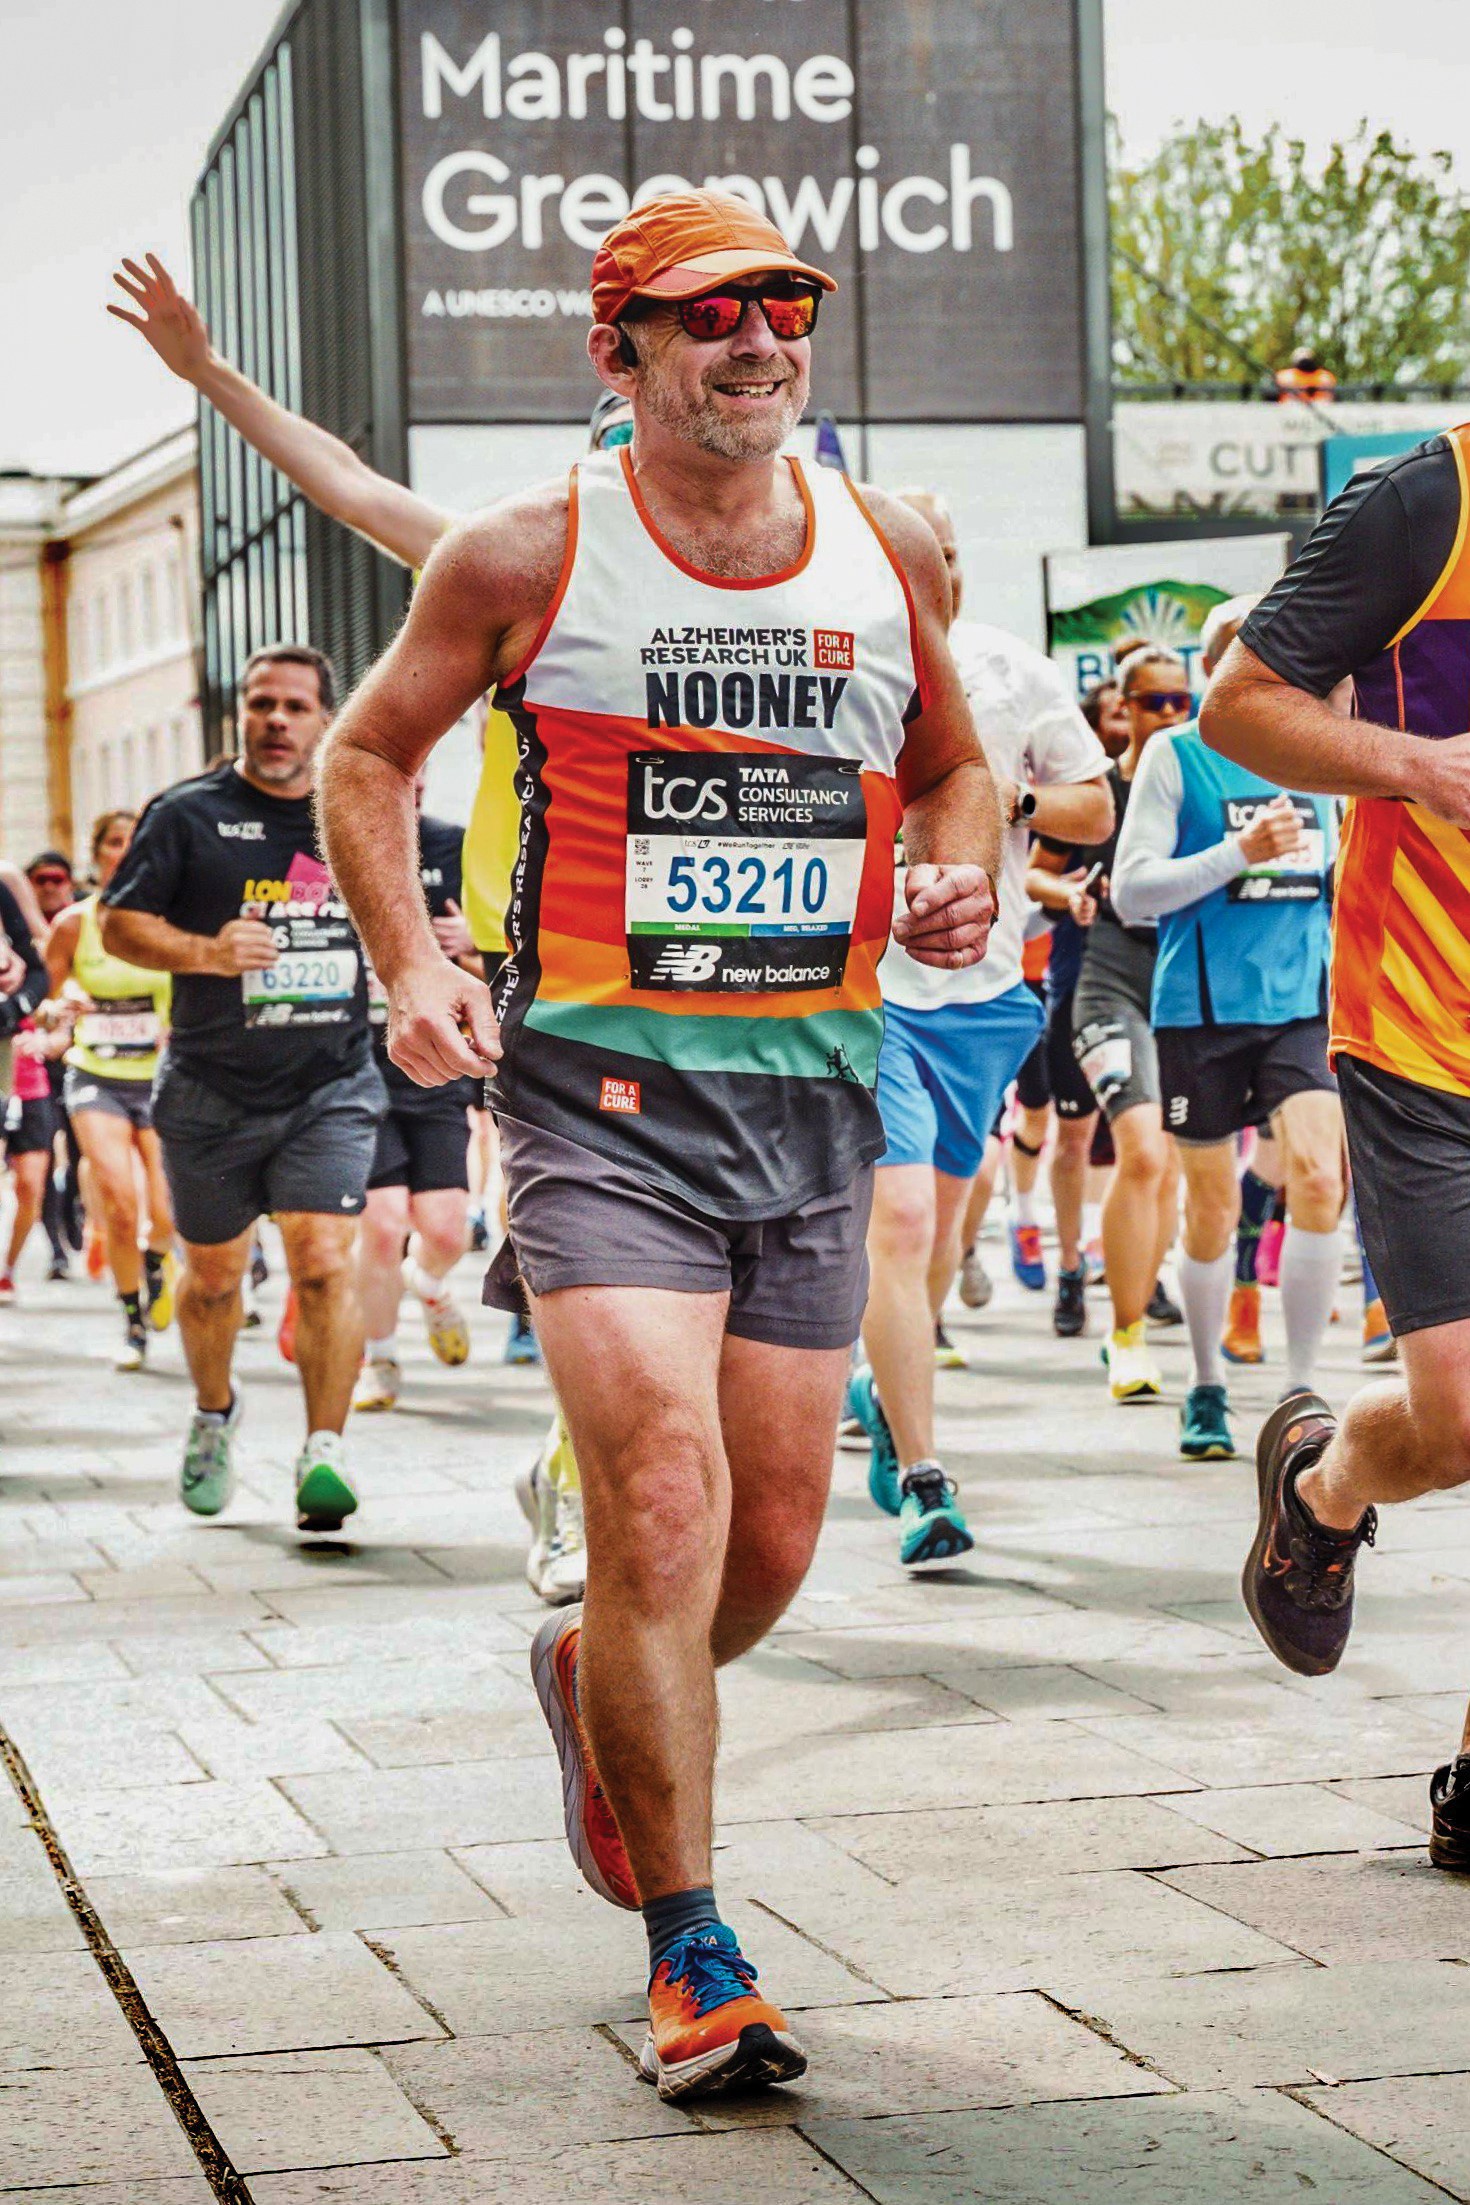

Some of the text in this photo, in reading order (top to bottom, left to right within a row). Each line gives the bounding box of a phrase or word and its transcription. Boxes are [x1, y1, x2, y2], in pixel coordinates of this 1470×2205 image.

[421, 27, 855, 122] Maritime
[421, 143, 1015, 252] Grewich
[446, 288, 557, 318] UNESCO
[650, 627, 807, 647] ALZHEIMER'S
[817, 633, 851, 650] FOR A
[640, 648, 808, 667] RESEARCH UK
[818, 650, 851, 667] CURE
[645, 670, 849, 729] NOONEY
[739, 767, 789, 784] TATA
[643, 765, 728, 821] tcs
[738, 787, 850, 806] CONSULTANCY
[738, 807, 814, 823] SERVICES
[666, 856, 828, 914] 53210
[650, 944, 830, 984] NB new balance
[605, 1080, 637, 1096] FOR A
[603, 1095, 637, 1111] CURE
